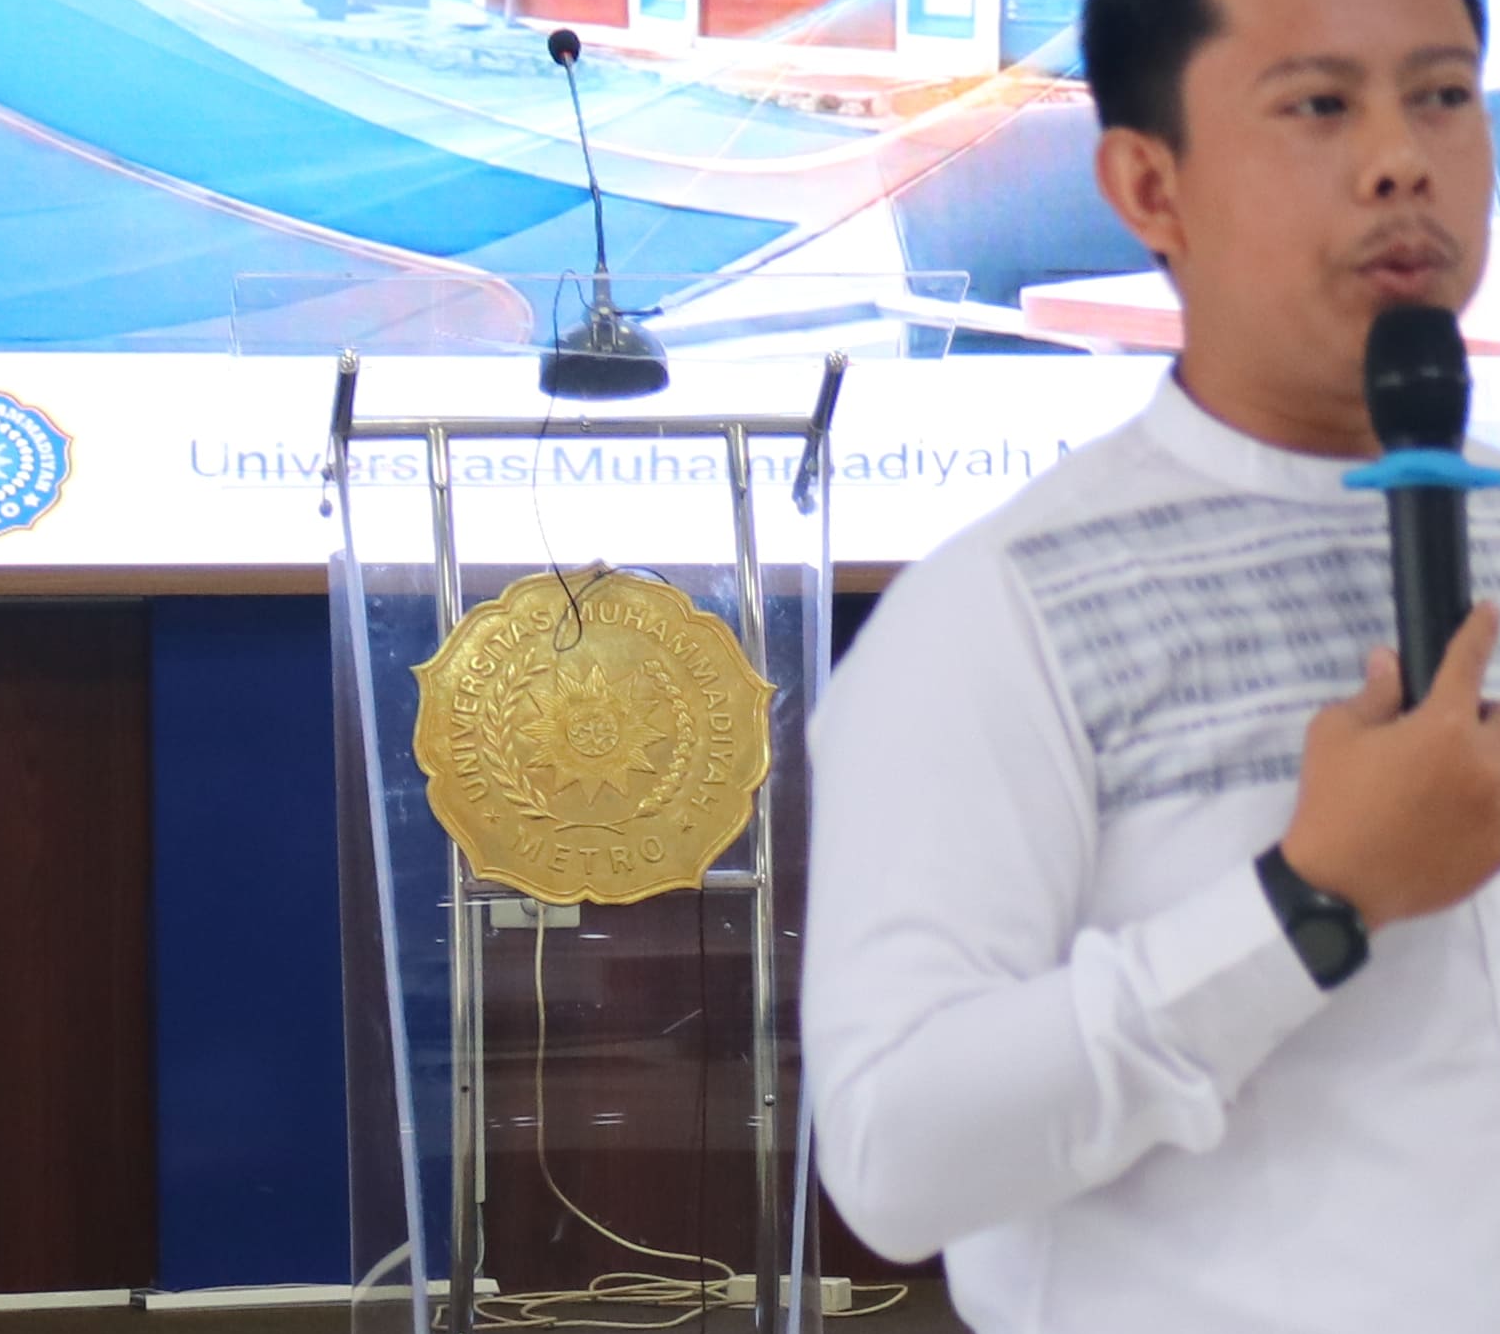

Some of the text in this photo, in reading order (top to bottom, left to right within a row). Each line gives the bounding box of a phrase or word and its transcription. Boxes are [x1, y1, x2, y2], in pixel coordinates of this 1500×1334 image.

[190, 438, 529, 482] Universas
[450, 601, 738, 816] UNIVERSITAS MUHAMMADIYAH
[508, 823, 667, 877] METRO
